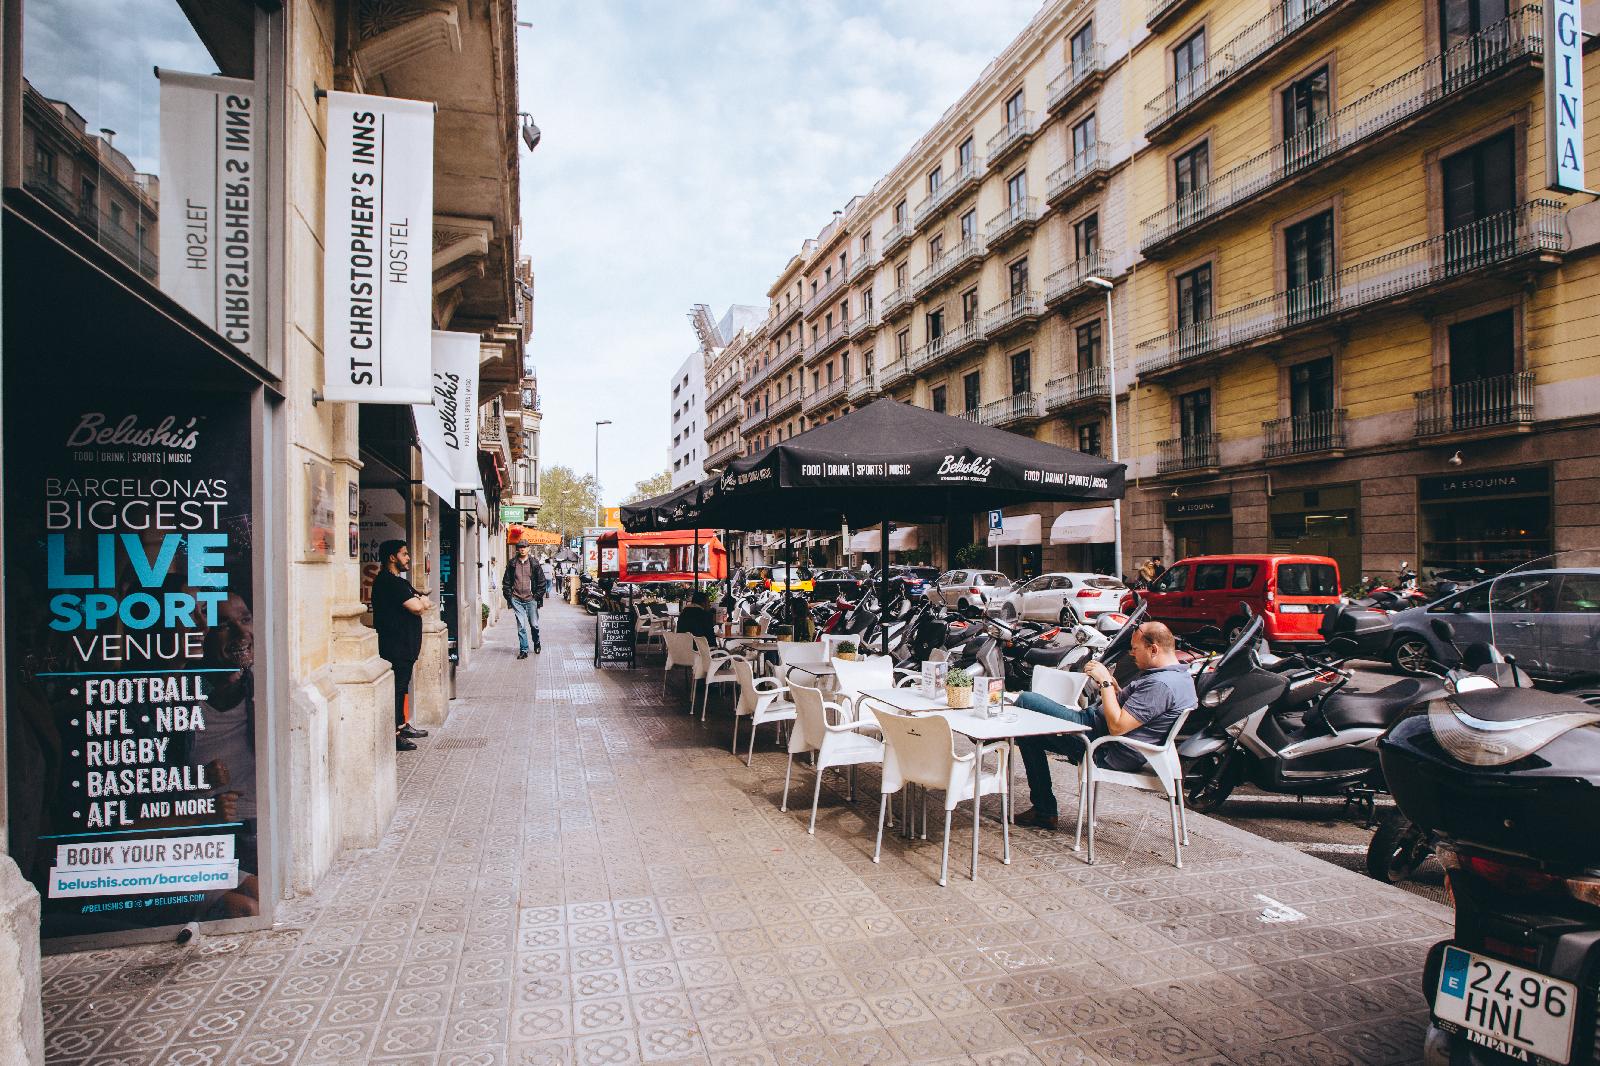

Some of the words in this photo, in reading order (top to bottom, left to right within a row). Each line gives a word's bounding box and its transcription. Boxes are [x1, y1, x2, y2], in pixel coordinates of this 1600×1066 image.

[1557, 0, 1580, 171] GINA
[352, 111, 376, 165] INNS
[350, 172, 374, 350] CHRISTOPHER'S
[389, 217, 409, 284] HOSTEL
[350, 357, 373, 386] ST
[66, 412, 200, 450] Belushi's
[101, 452, 125, 462] DRINK
[132, 452, 161, 463] SPORTS
[168, 453, 192, 463] MUSIC
[802, 464, 821, 476] FOOD
[828, 464, 850, 476] DRINK
[856, 464, 883, 476] SPORTS
[889, 464, 911, 476] MUSIC
[937, 455, 992, 476] Belushi's
[46, 478, 228, 498] BARCELONA'S
[1024, 470, 1040, 481] FOOD
[1068, 474, 1090, 487] SPORTS
[1443, 482, 1456, 490] LA
[1462, 477, 1518, 489] ESQUINA
[46, 500, 229, 530] BIGGEST
[991, 512, 999, 528] P
[47, 533, 229, 589] LIVE
[48, 591, 229, 632] SPORT
[72, 632, 204, 662] VENUE
[85, 676, 209, 705] FOOTBALL
[86, 708, 134, 736] NFL
[155, 706, 206, 733] NBA
[86, 737, 170, 767] RUGBY
[87, 764, 212, 798] BASEBALL
[87, 801, 134, 829] AFL
[140, 801, 170, 819] AND
[175, 798, 216, 817] MORE
[67, 846, 115, 866] BOOK
[121, 844, 166, 864] YOUR
[172, 841, 225, 861] SPACE
[58, 871, 229, 891] belushis.com/barcelona
[1448, 976, 1460, 989] E
[1470, 961, 1568, 1018] 2496
[1464, 992, 1534, 1046] HNL
[1466, 1029, 1529, 1063] IMPALA
